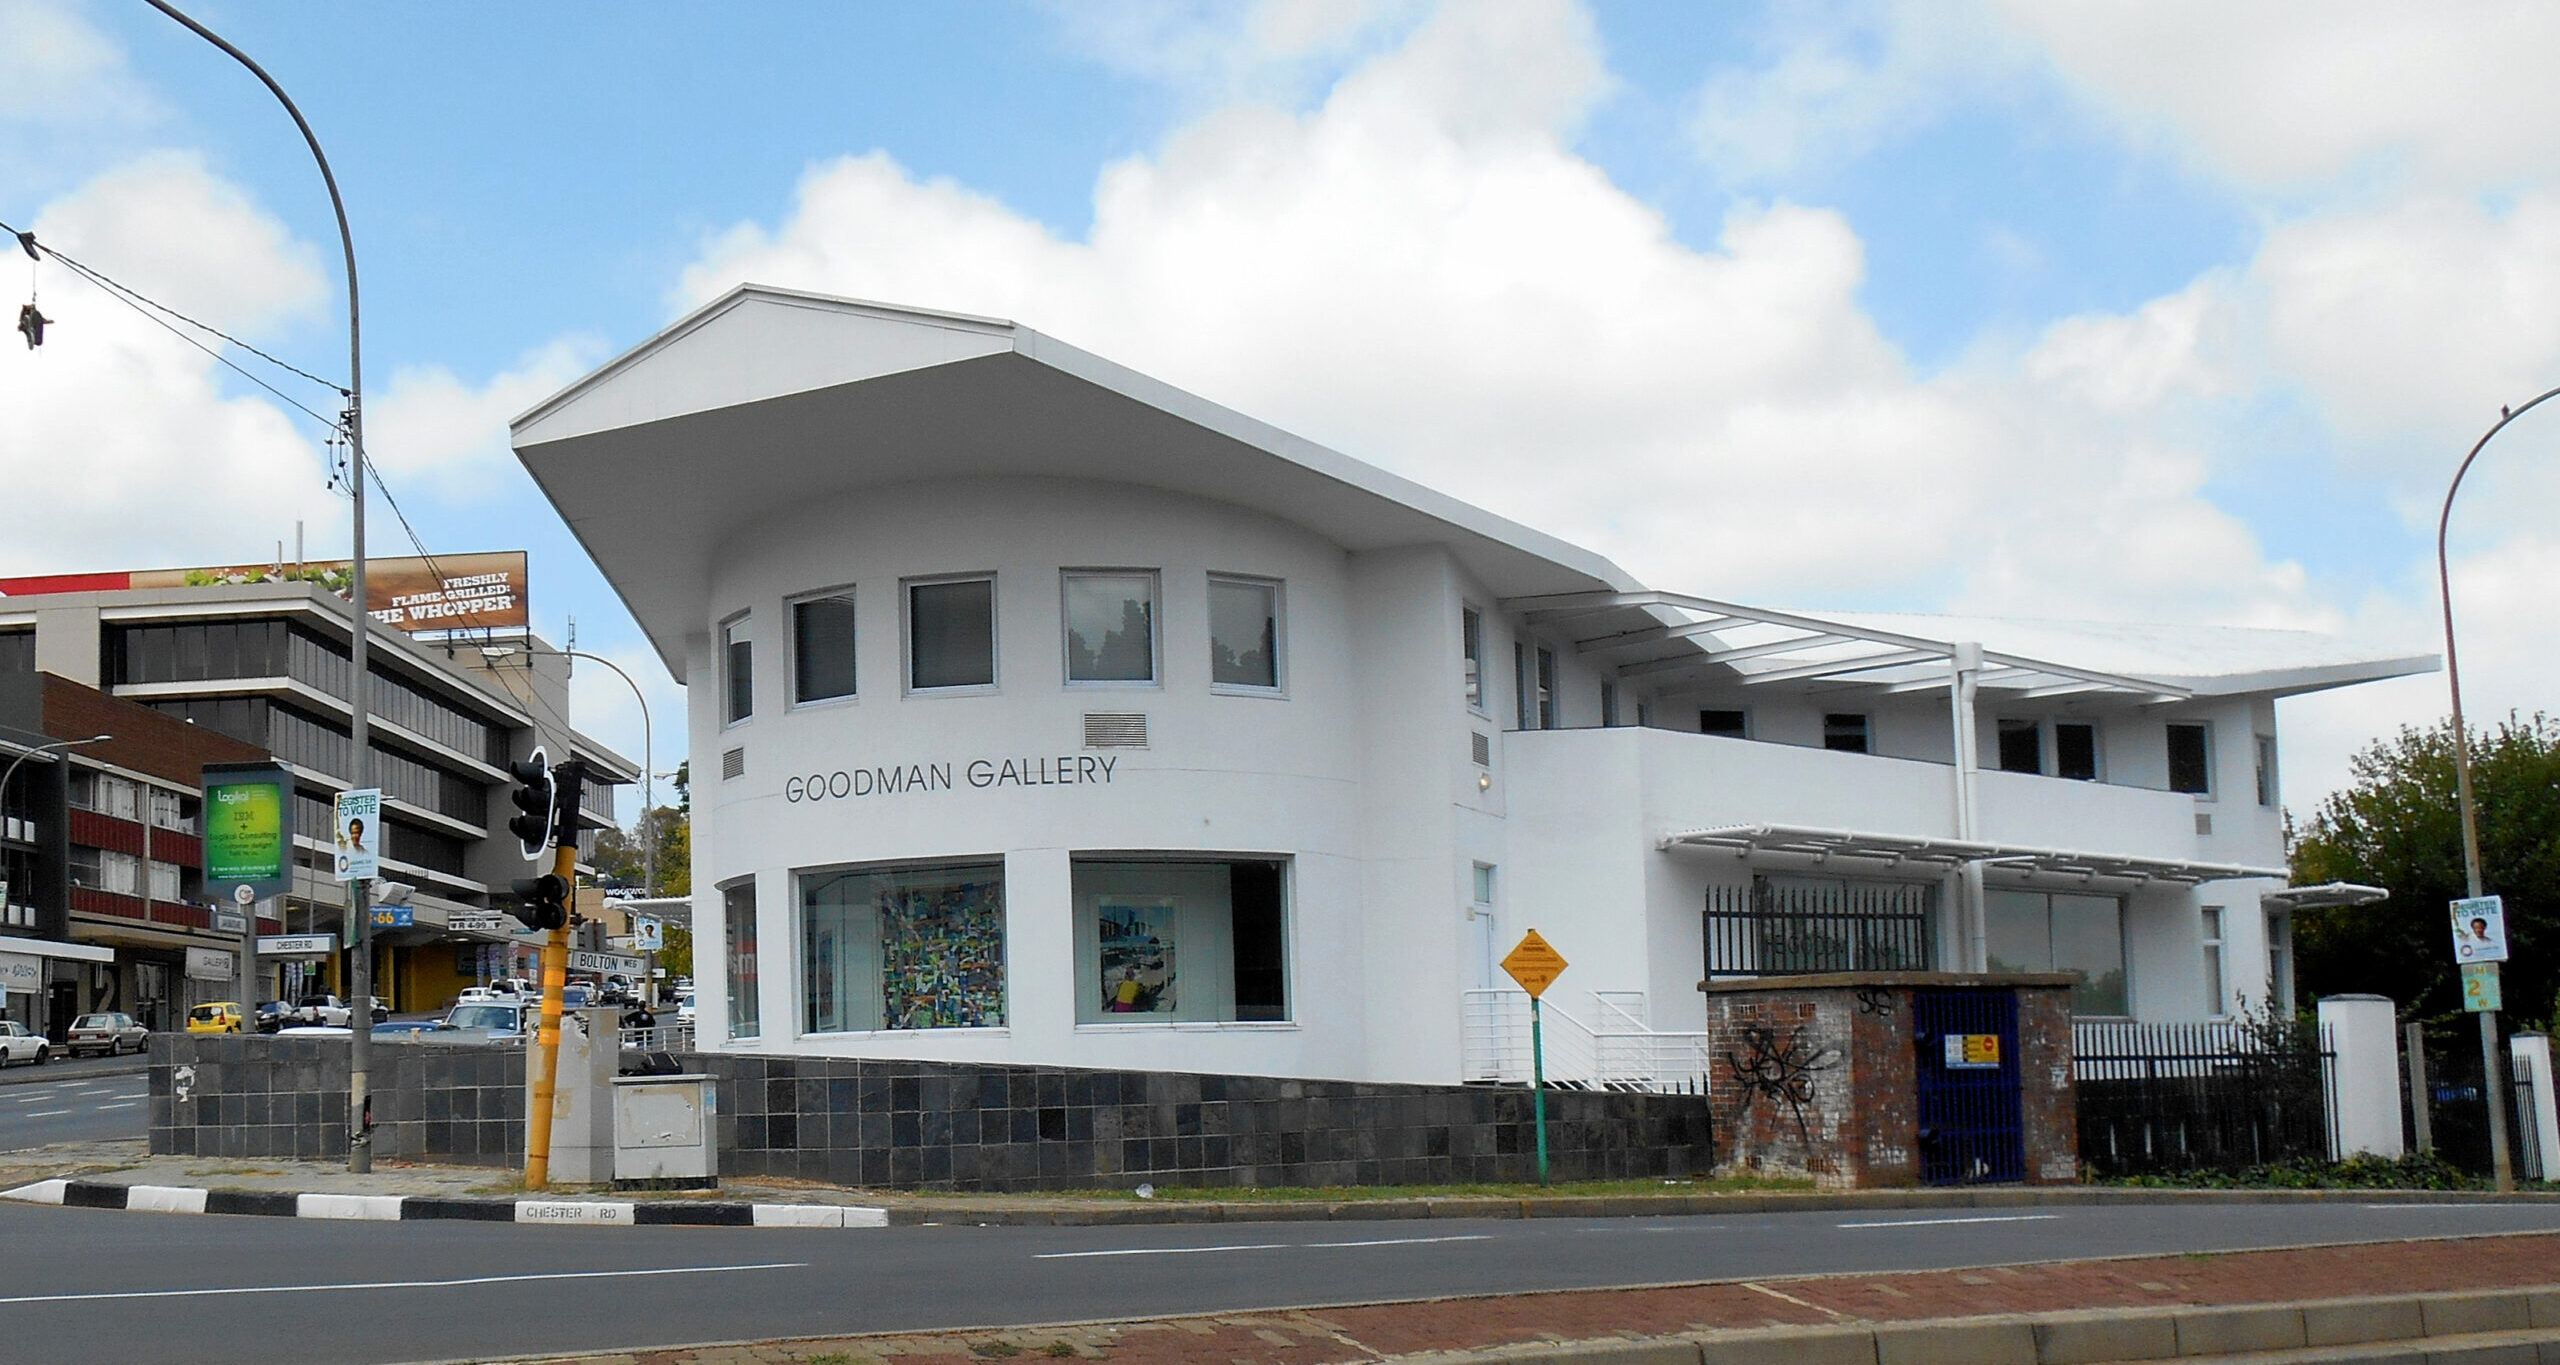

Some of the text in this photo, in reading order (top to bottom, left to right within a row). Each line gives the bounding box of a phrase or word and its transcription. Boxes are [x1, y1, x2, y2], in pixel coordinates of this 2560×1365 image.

[444, 573, 509, 589] FRESHLY
[786, 756, 1117, 803] GOODMAN GALLERY
[338, 804, 377, 817] TO VOTE
[2471, 906, 2498, 917] VOTE
[276, 940, 313, 950] CHESTER RD
[580, 954, 619, 971] BOLTON
[2467, 979, 2481, 997] 2
[526, 1206, 617, 1219] CHESTER RD
